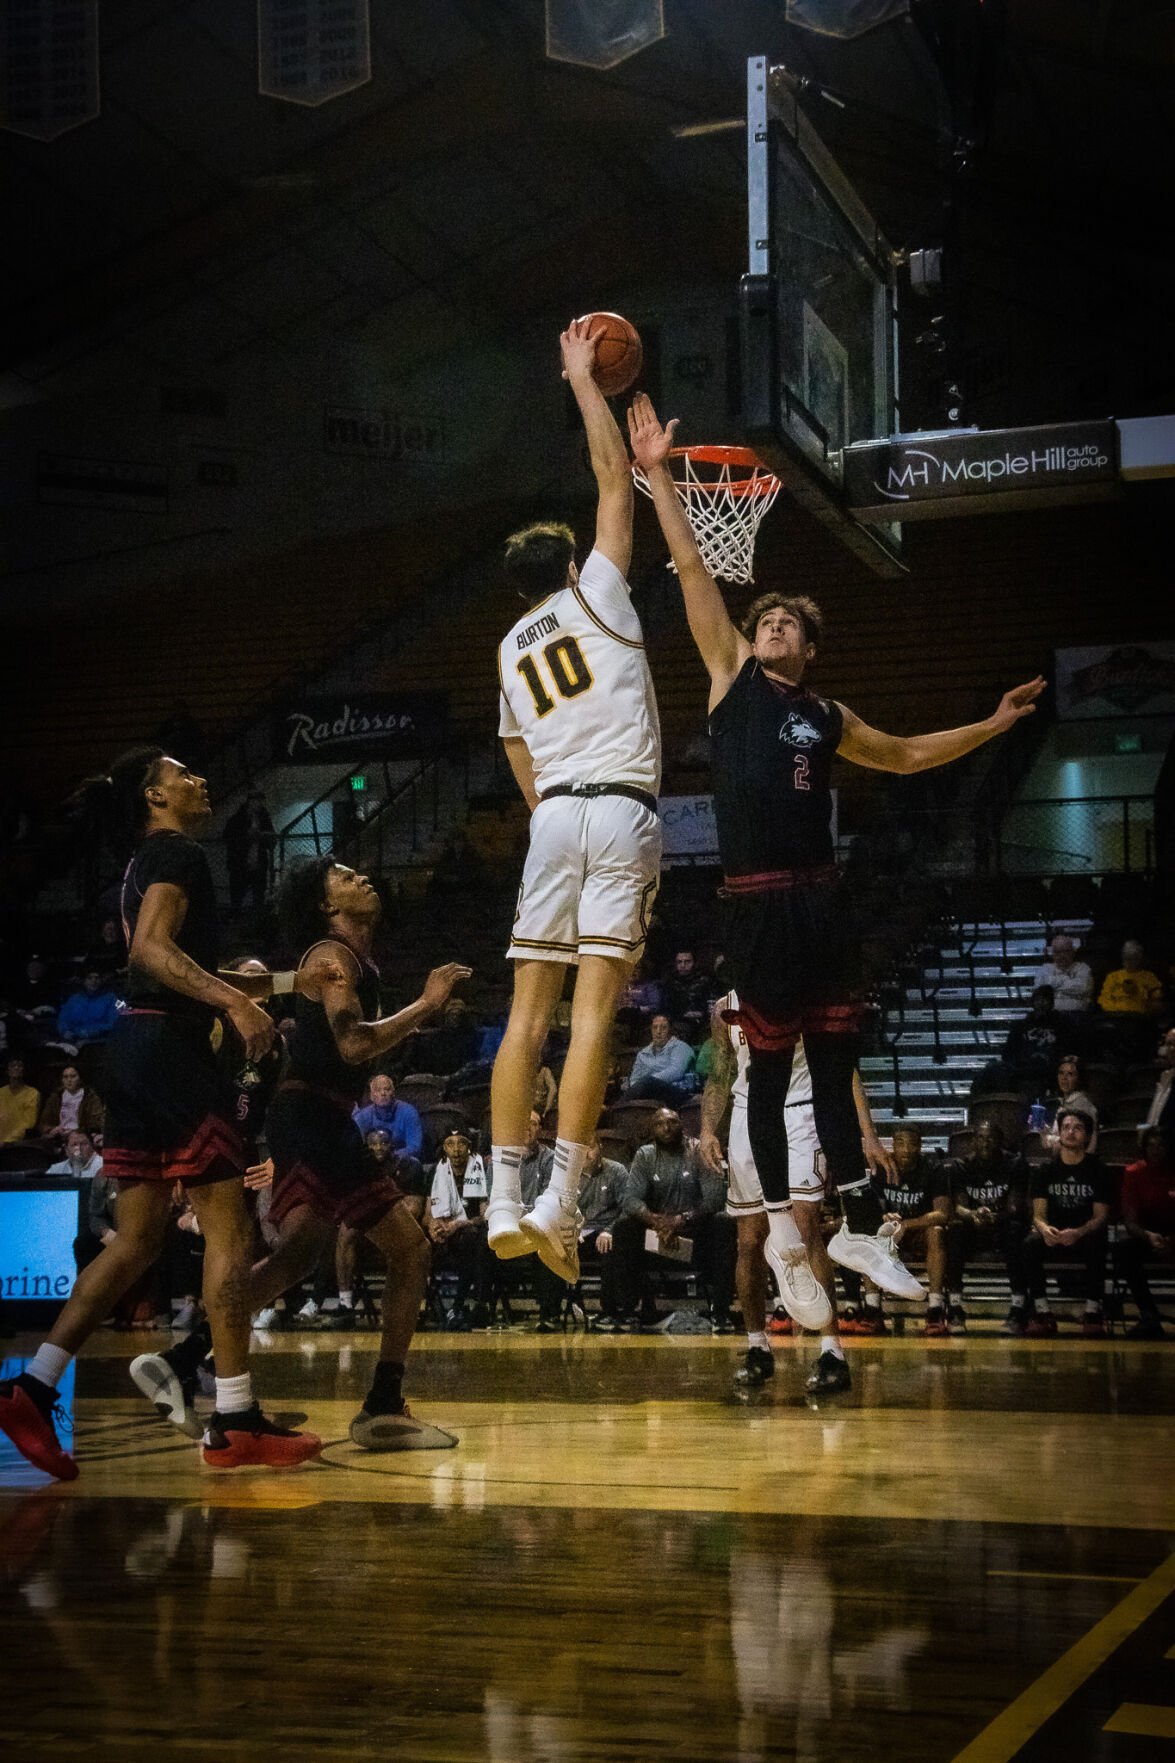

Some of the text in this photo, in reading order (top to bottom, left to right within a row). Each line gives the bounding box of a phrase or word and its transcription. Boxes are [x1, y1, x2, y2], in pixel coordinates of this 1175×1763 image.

[1066, 445, 1099, 457] auto
[1066, 455, 1109, 471] group
[516, 612, 560, 650] BURTON
[517, 635, 594, 719] 10
[793, 754, 811, 791] 2
[237, 1093, 249, 1121] 5
[0, 1266, 70, 1297] rine
